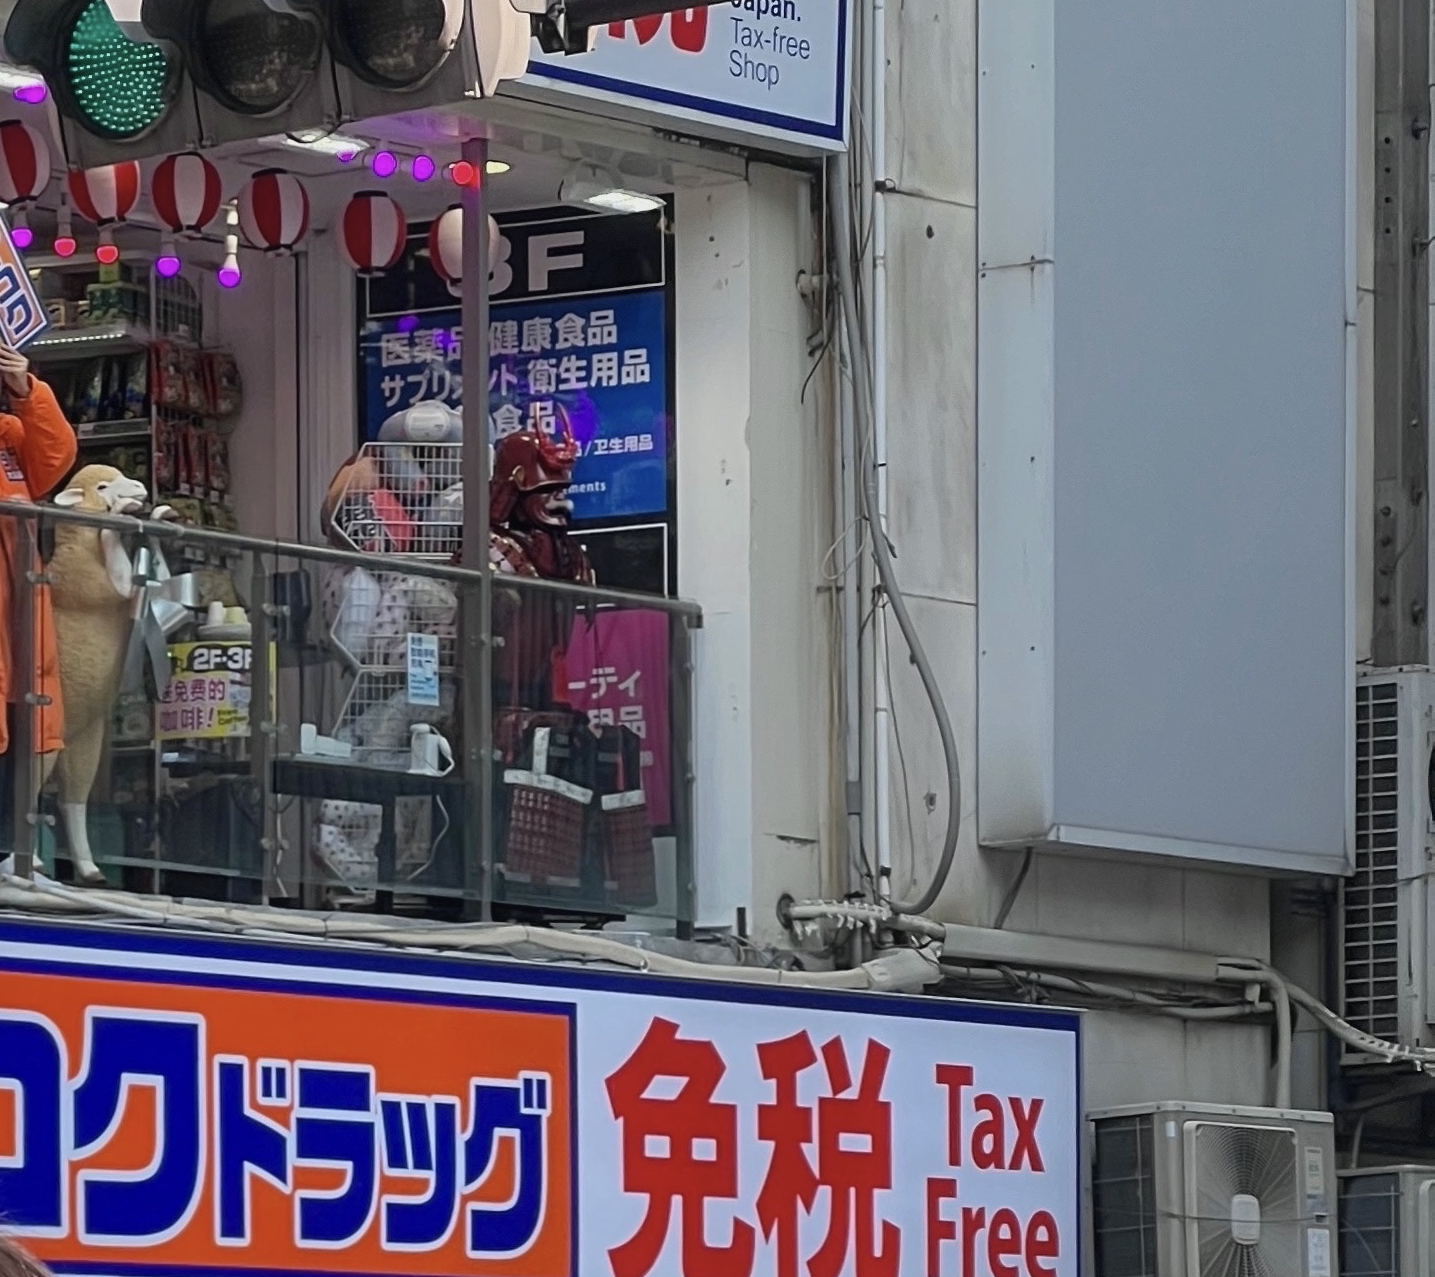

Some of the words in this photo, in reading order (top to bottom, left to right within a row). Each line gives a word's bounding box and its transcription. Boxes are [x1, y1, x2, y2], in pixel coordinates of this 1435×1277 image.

[730, 16, 811, 60] Tax-free
[729, 49, 780, 90] Shop
[488, 309, 618, 358] 健康食品
[527, 348, 651, 395] 衛生用品
[566, 481, 607, 495] ments
[935, 1062, 1048, 1173] Tax
